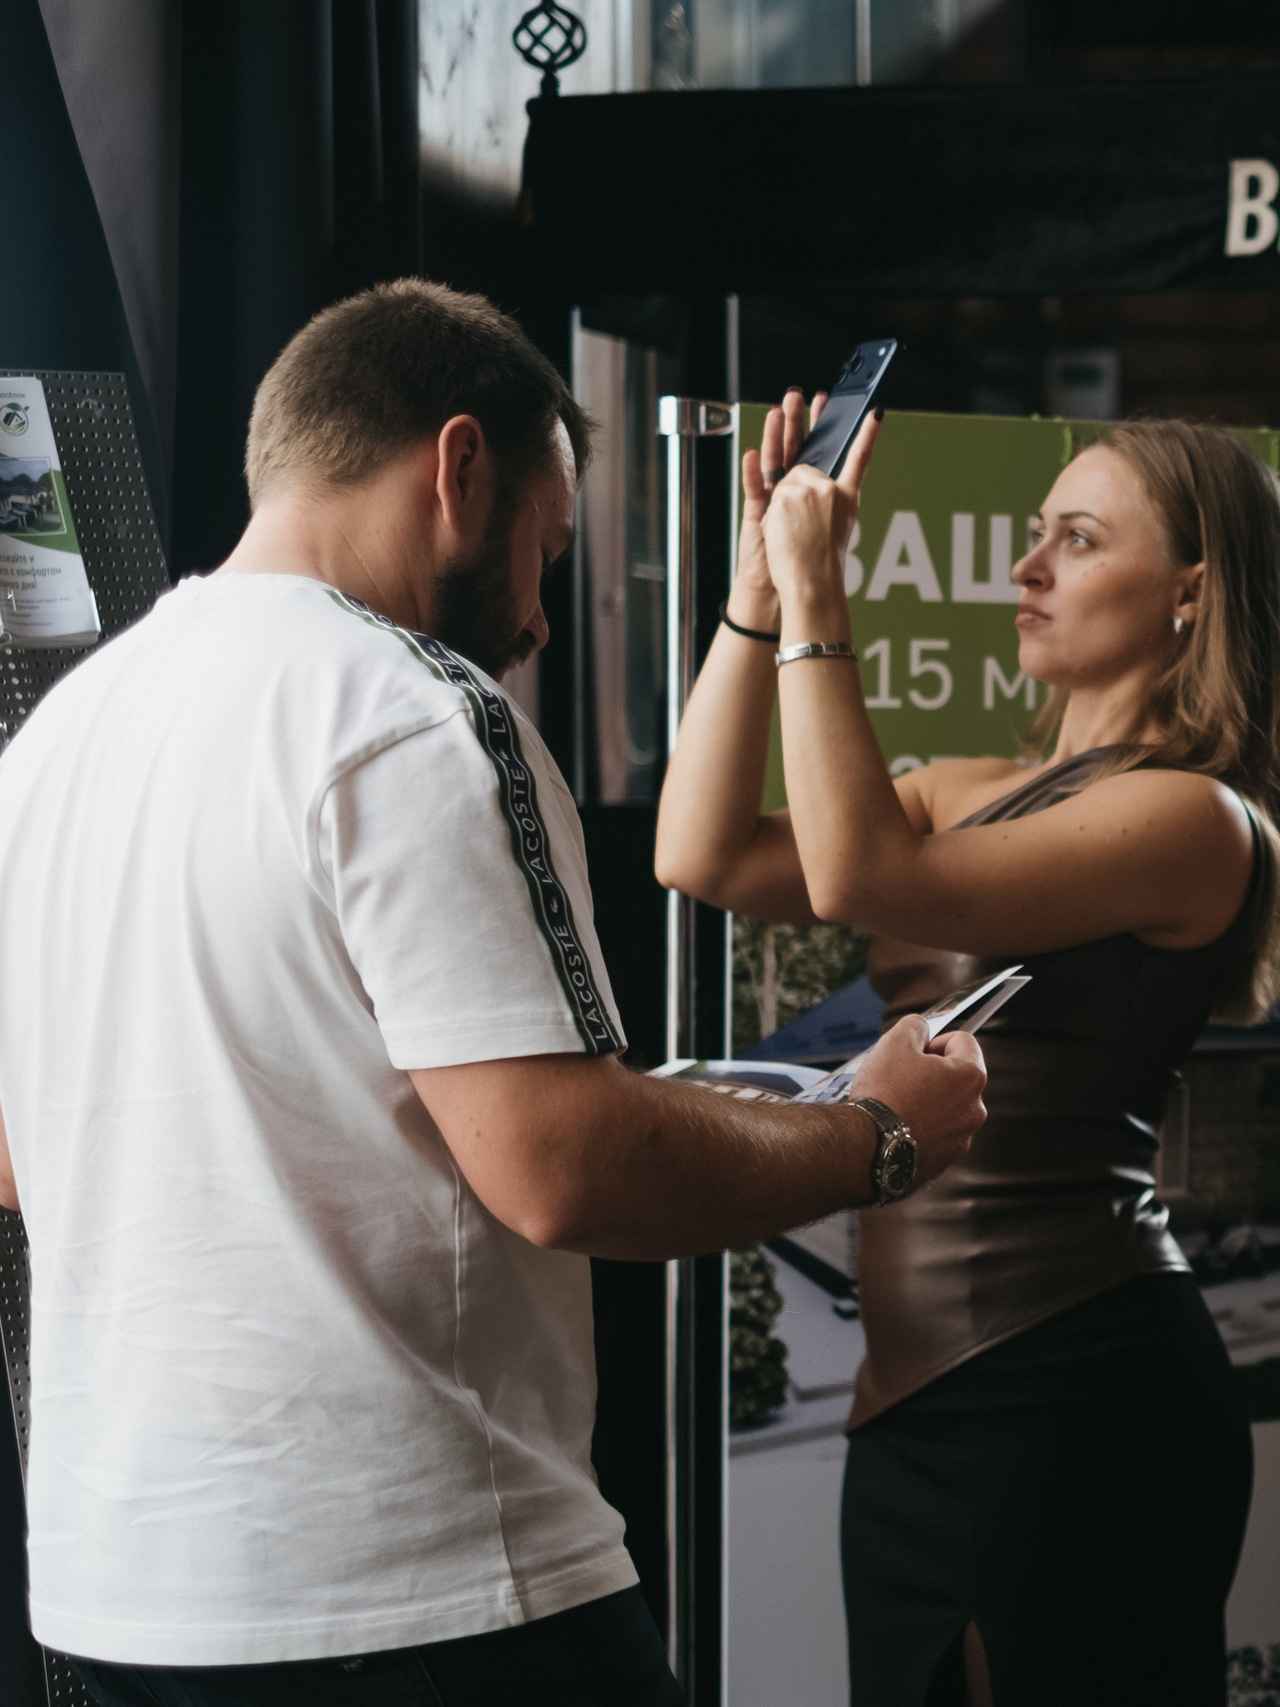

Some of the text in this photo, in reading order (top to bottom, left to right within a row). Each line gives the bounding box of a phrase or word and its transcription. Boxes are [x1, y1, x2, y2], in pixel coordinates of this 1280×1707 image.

[863, 636, 953, 711] 15
[512, 768, 555, 884] LACOSTE
[555, 924, 609, 1041] LACOSTE
